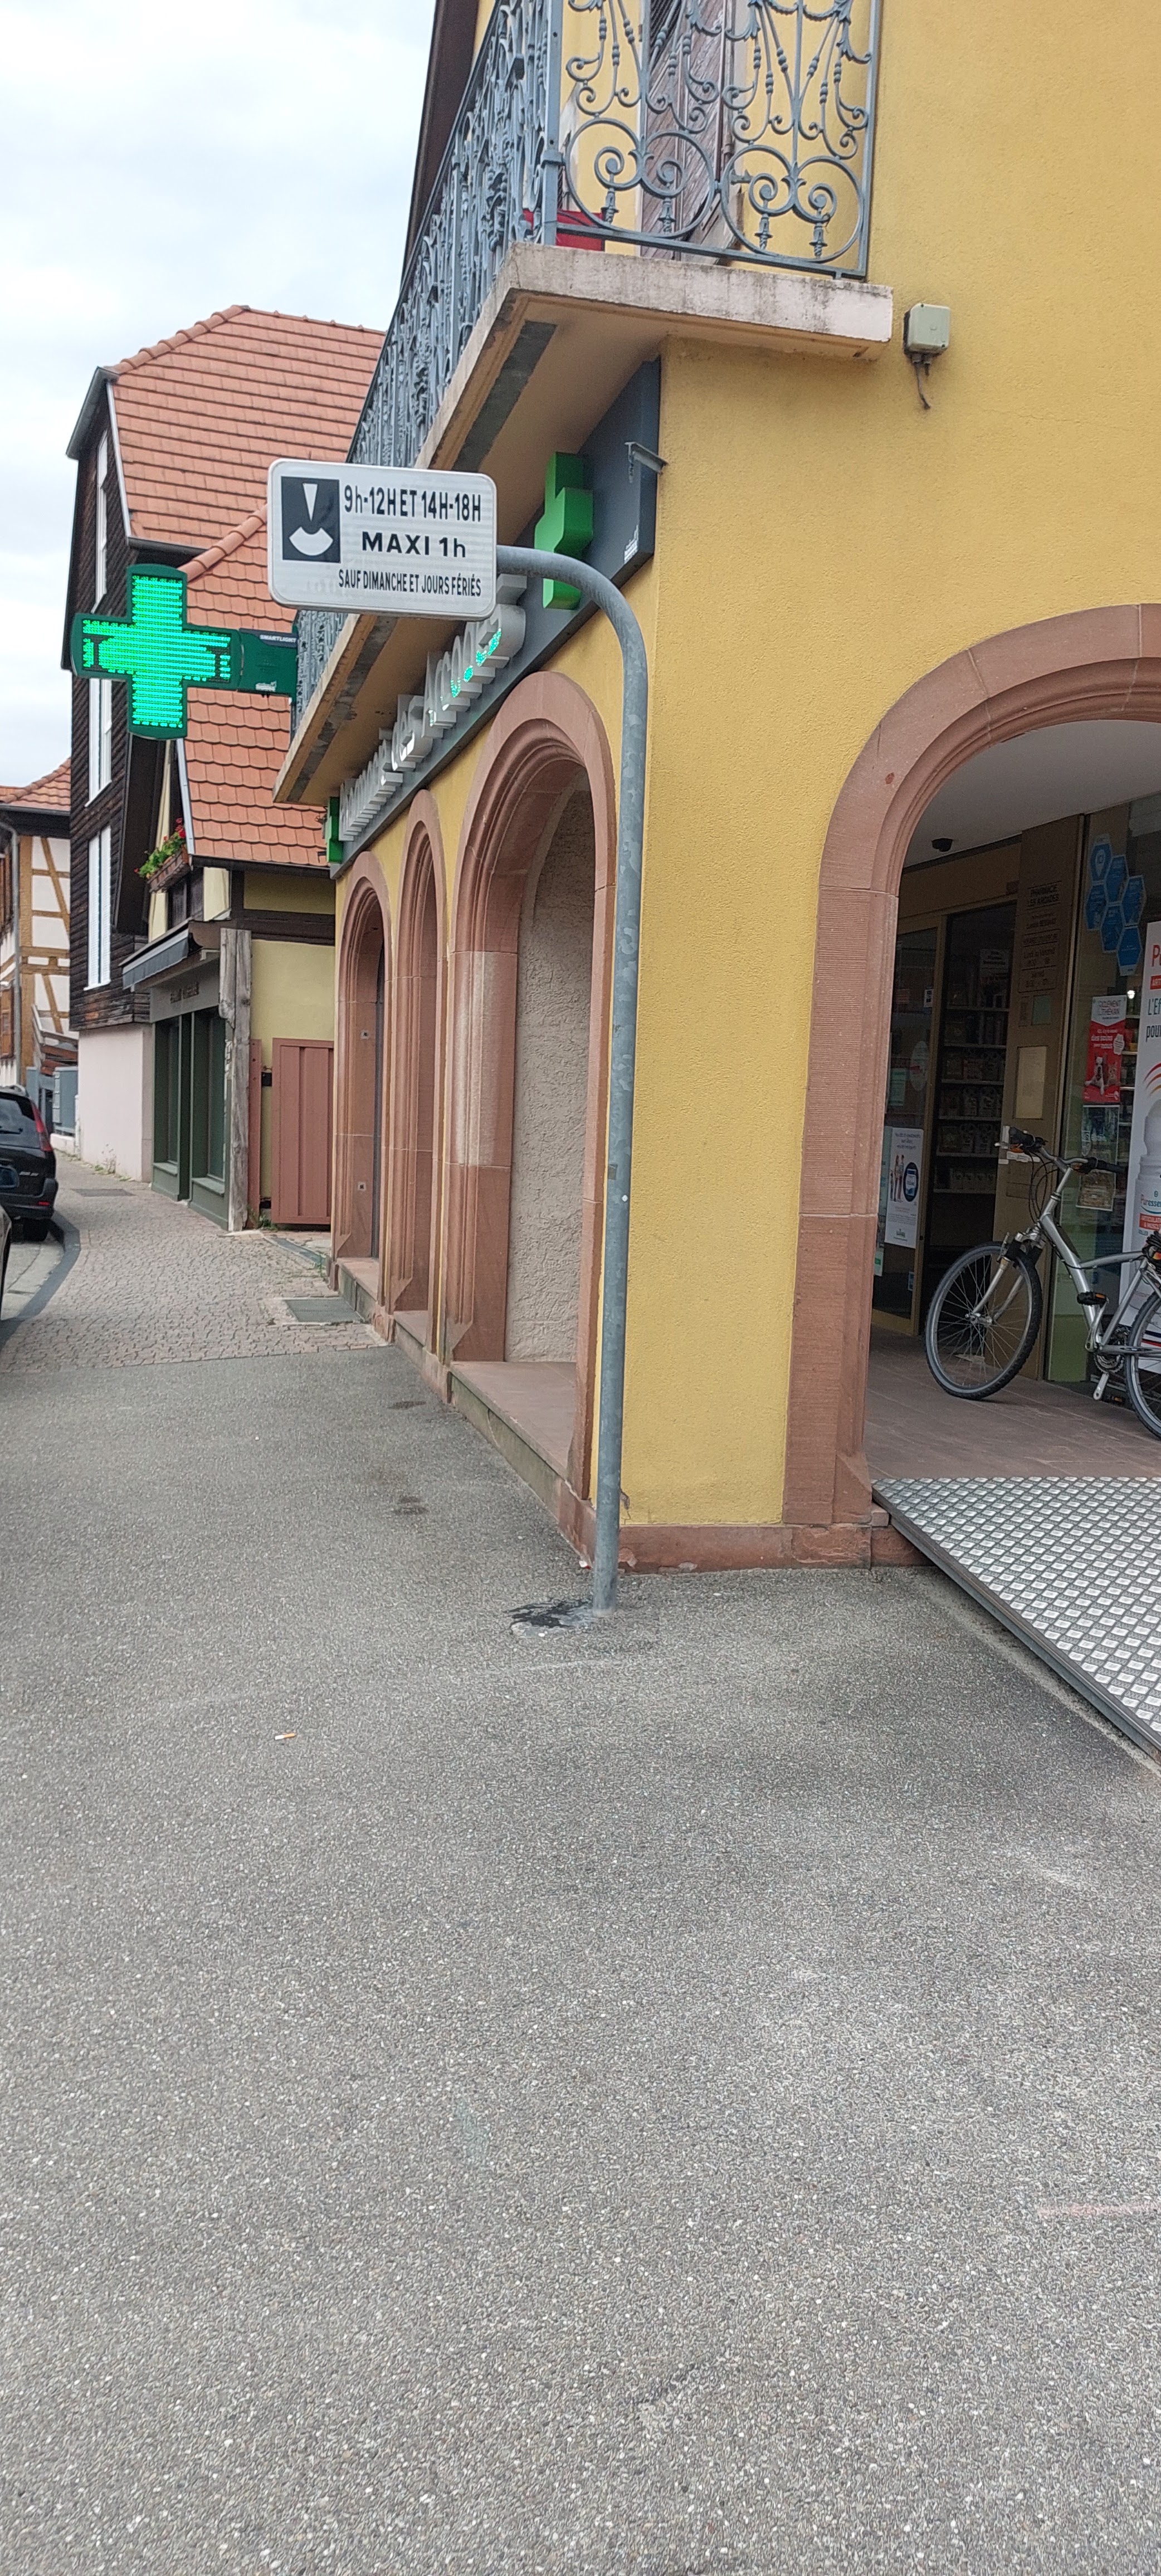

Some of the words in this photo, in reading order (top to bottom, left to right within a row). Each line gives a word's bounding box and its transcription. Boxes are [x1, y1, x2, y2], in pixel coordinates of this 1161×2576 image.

[344, 485, 396, 516] 9h-12H
[400, 490, 417, 518] ET
[421, 490, 481, 523] 14H-18H
[362, 531, 430, 555] MAXI
[438, 537, 466, 558] 1h
[338, 569, 361, 589] SAUF
[363, 570, 407, 592] DIMANCHE
[409, 574, 419, 593] ET
[421, 575, 450, 594] JOURS
[451, 573, 481, 597] FÉRIÉS
